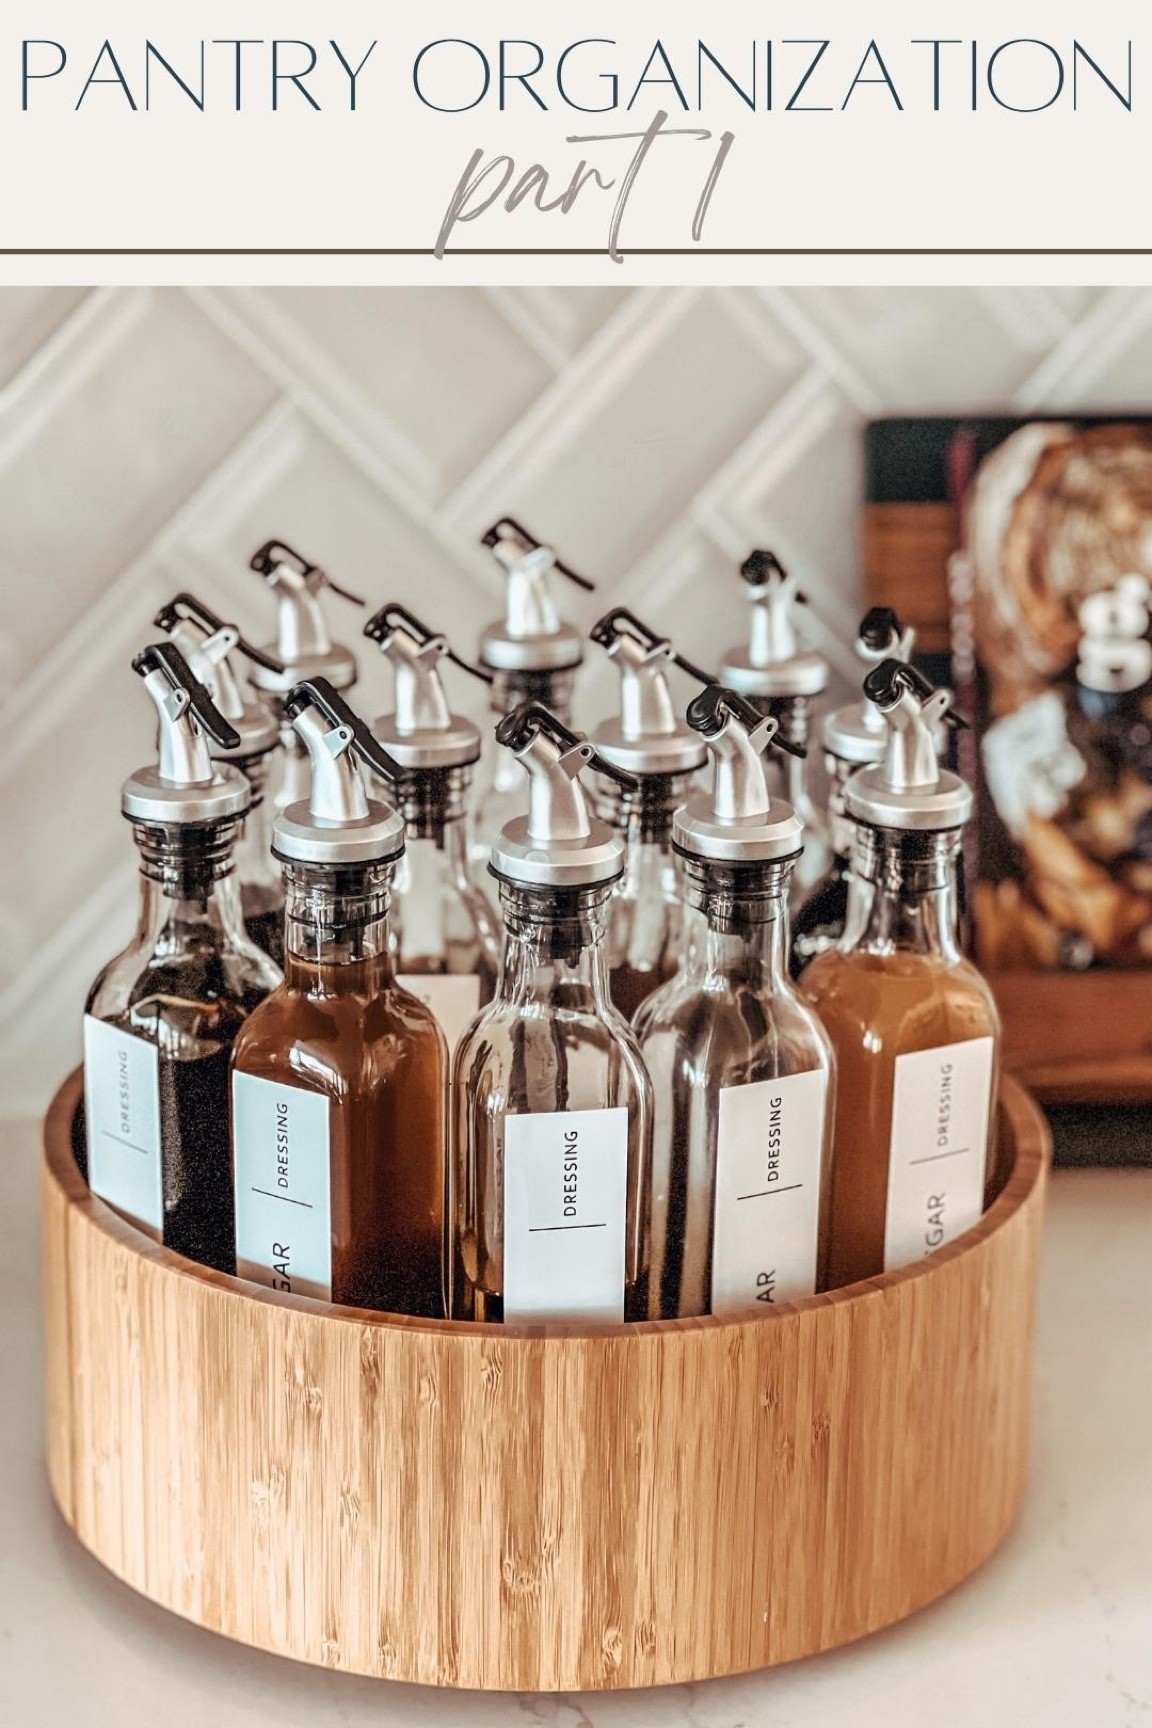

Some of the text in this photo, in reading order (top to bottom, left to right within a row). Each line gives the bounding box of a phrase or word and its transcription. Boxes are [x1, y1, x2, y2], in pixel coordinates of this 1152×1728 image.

[118, 1051, 130, 1134] DRESSING
[937, 1062, 953, 1147] DRESSING
[277, 1102, 289, 1189] DRESSING
[564, 1130, 578, 1216] DRESSING
[767, 1097, 783, 1182] DRESSING
